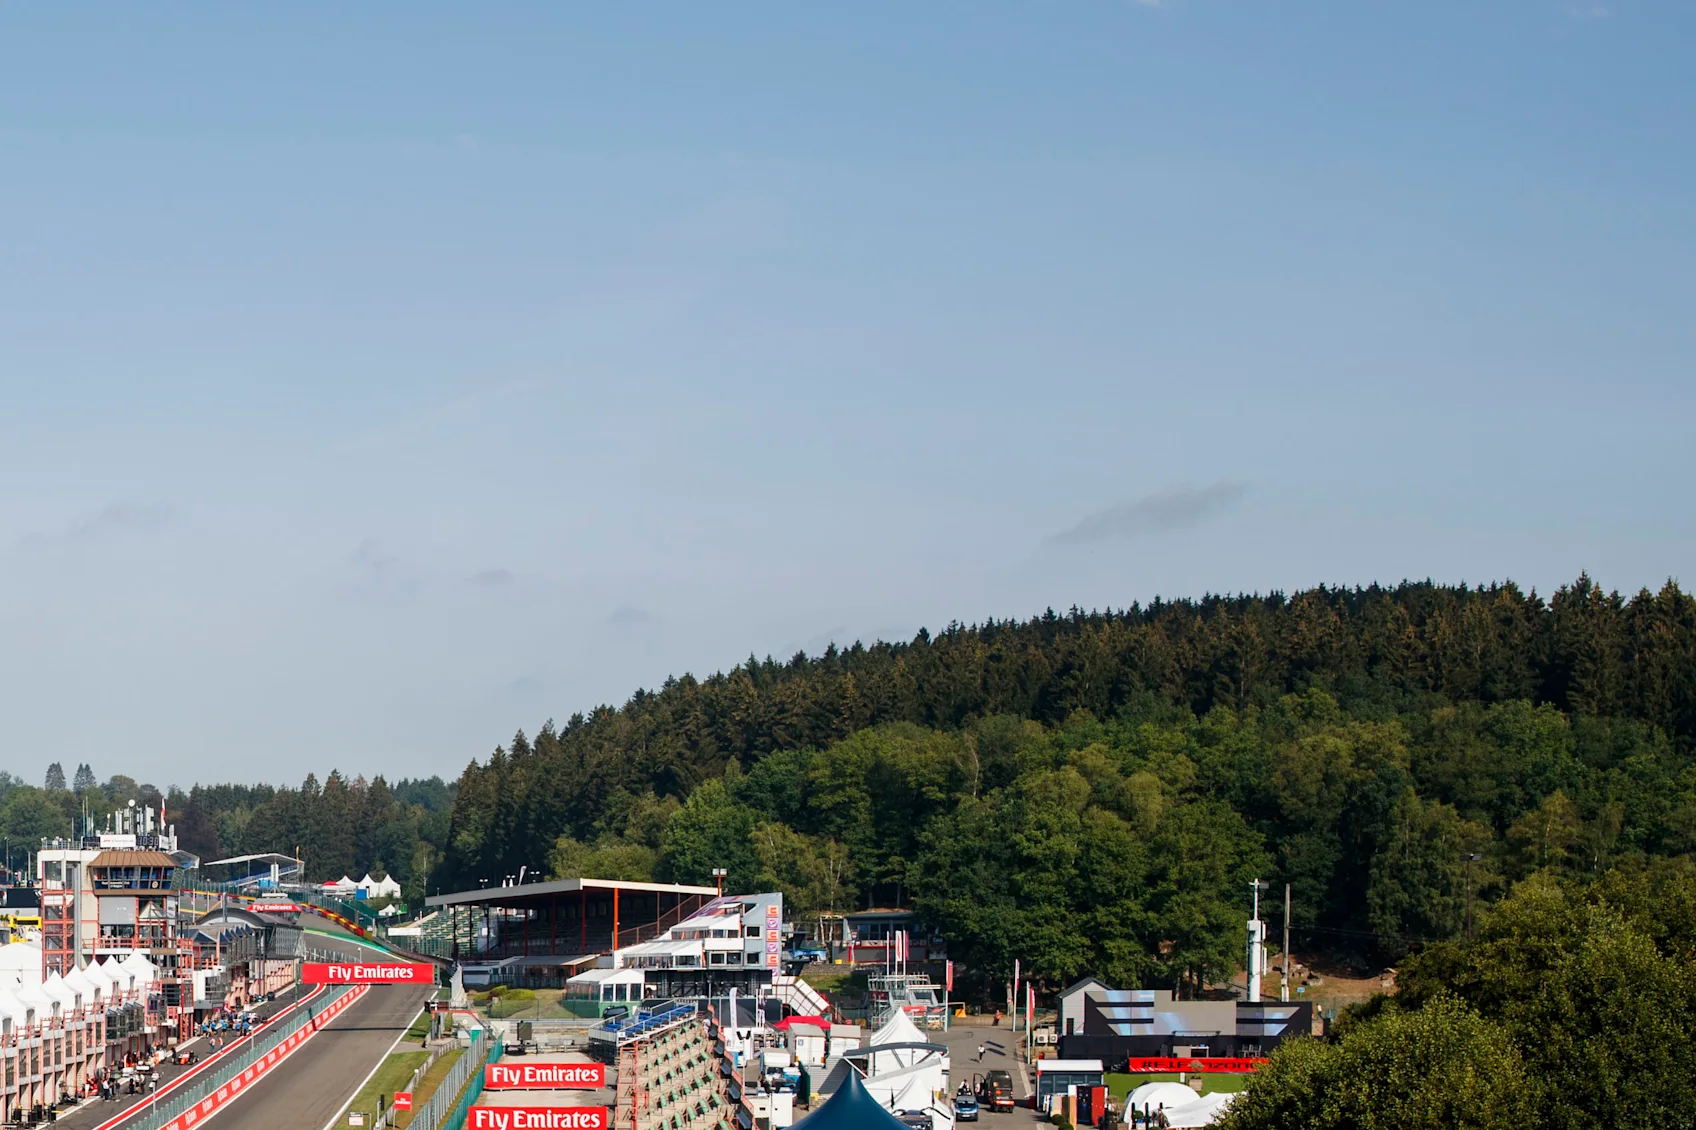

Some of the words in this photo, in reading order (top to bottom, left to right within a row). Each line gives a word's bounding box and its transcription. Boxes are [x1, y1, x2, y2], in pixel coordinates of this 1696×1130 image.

[328, 966, 352, 981] Fly
[354, 965, 414, 978] Emirates
[492, 1067, 520, 1085] Fly
[524, 1066, 599, 1082] Emirates
[513, 1110, 600, 1128] Emirates
